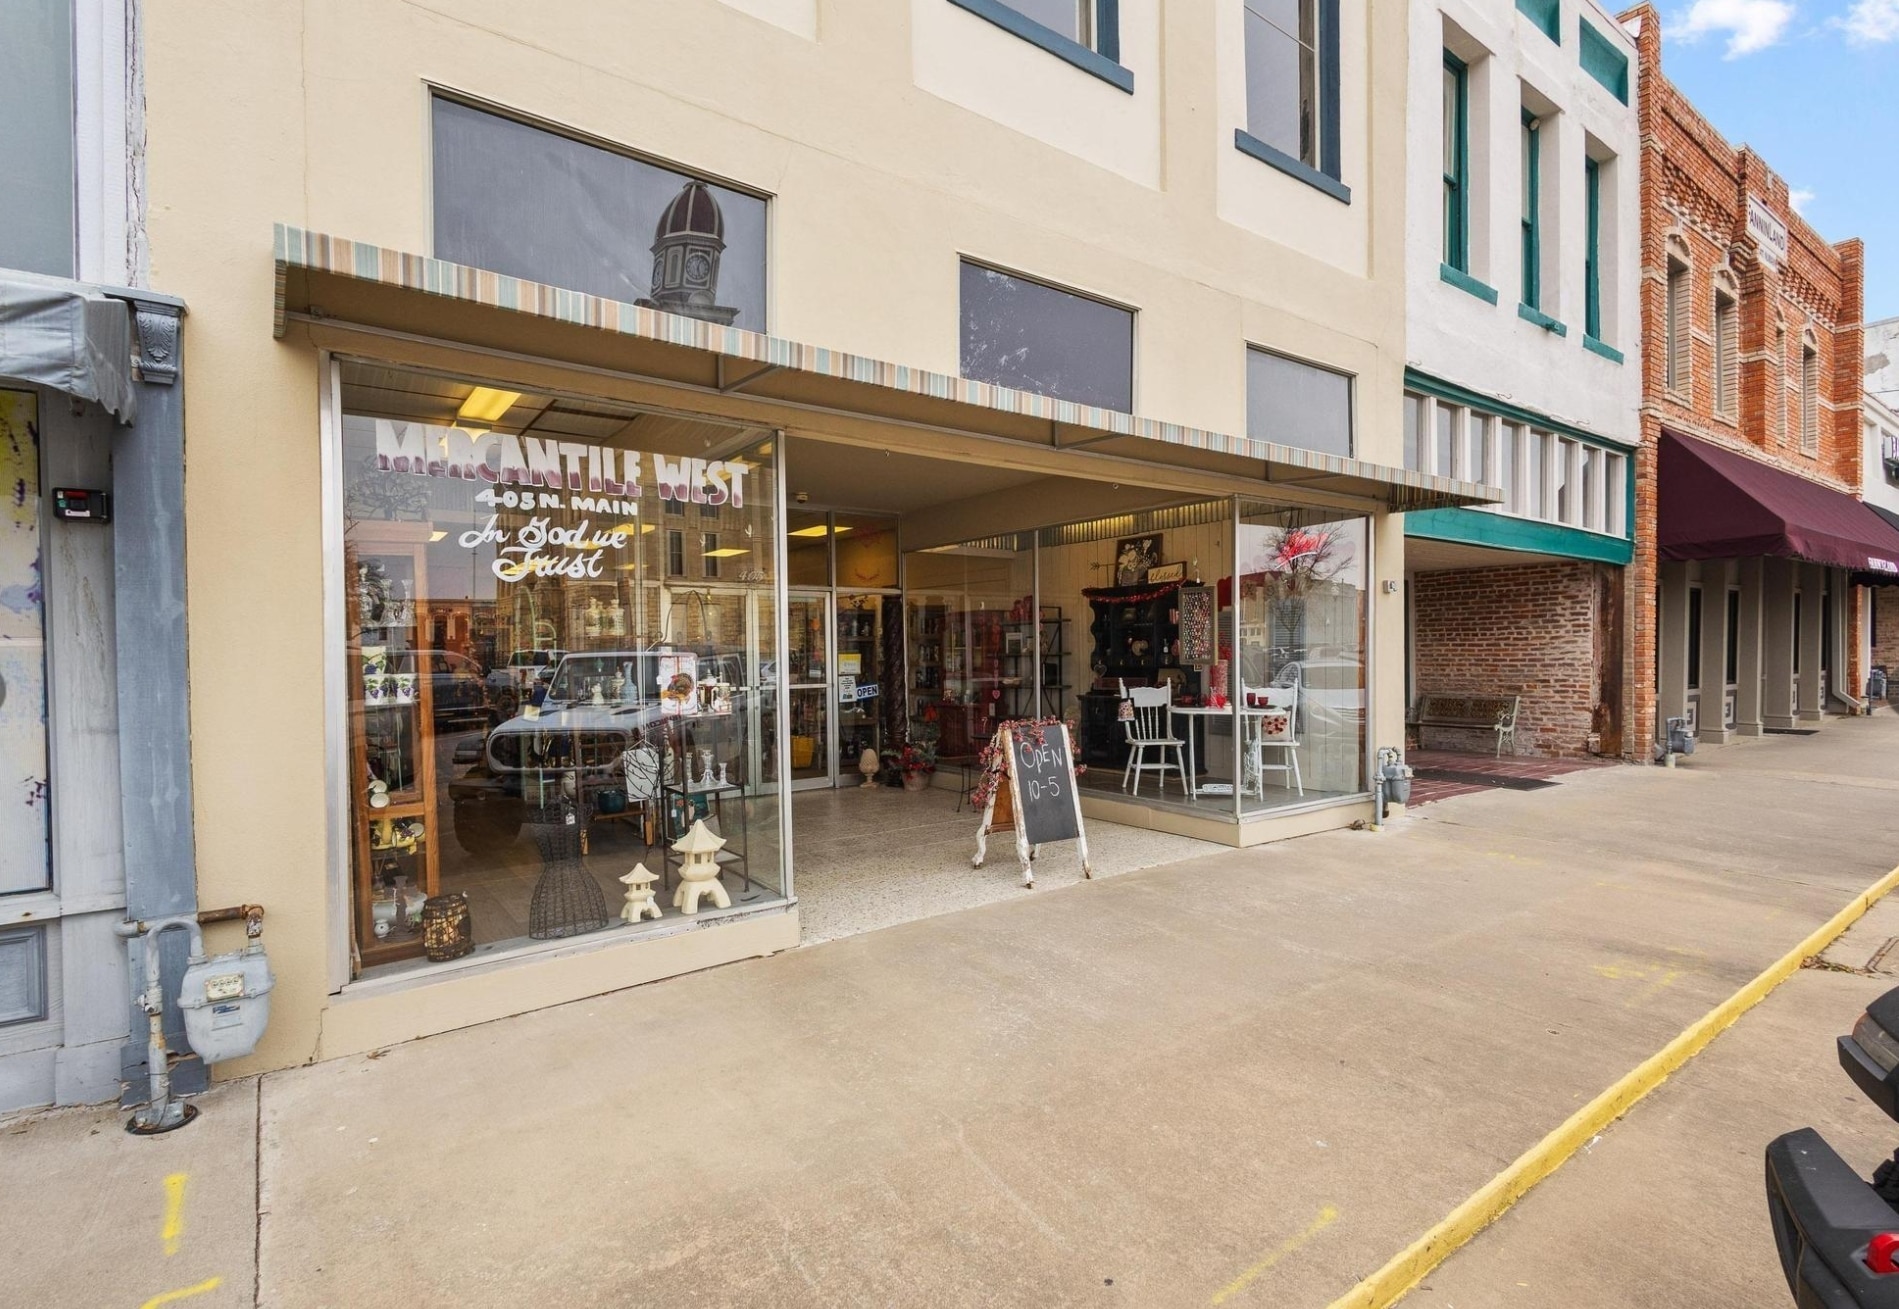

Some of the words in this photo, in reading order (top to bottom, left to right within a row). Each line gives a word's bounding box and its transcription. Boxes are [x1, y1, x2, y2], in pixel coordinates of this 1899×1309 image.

[375, 418, 642, 498] MERCANTILE
[653, 453, 749, 509] WEST
[571, 496, 638, 516] MAIN
[458, 513, 511, 548] In
[516, 516, 590, 549] God
[592, 528, 628, 549] we
[491, 546, 604, 583] Trust
[857, 686, 877, 698] OPEN
[1028, 775, 1060, 802] 10-5
